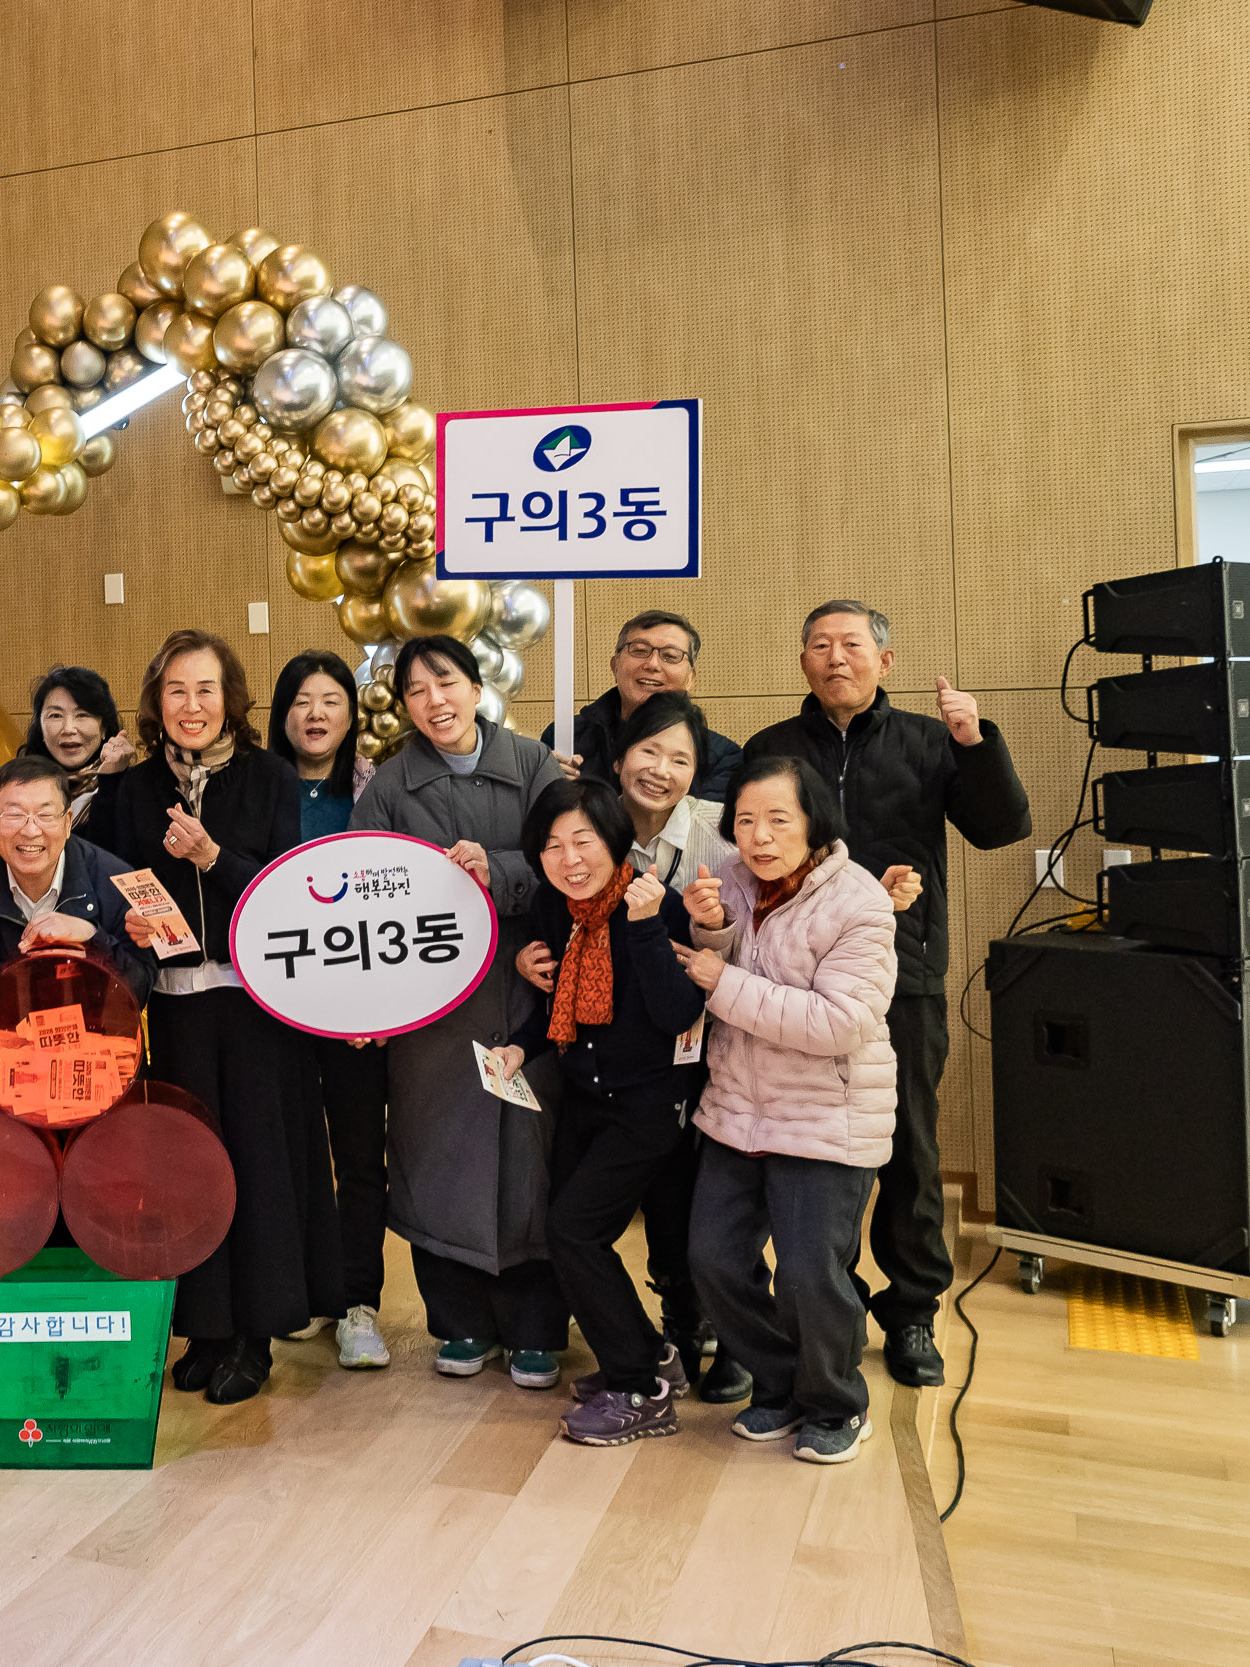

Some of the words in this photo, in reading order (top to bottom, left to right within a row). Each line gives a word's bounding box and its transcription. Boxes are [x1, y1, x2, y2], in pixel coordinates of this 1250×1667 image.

[464, 486, 667, 543] 구의3동
[354, 878, 411, 900] 행복광진
[264, 912, 464, 979] 구의3동
[39, 1031, 80, 1048] 따뜻한
[73, 1060, 85, 1101] 따뜻한
